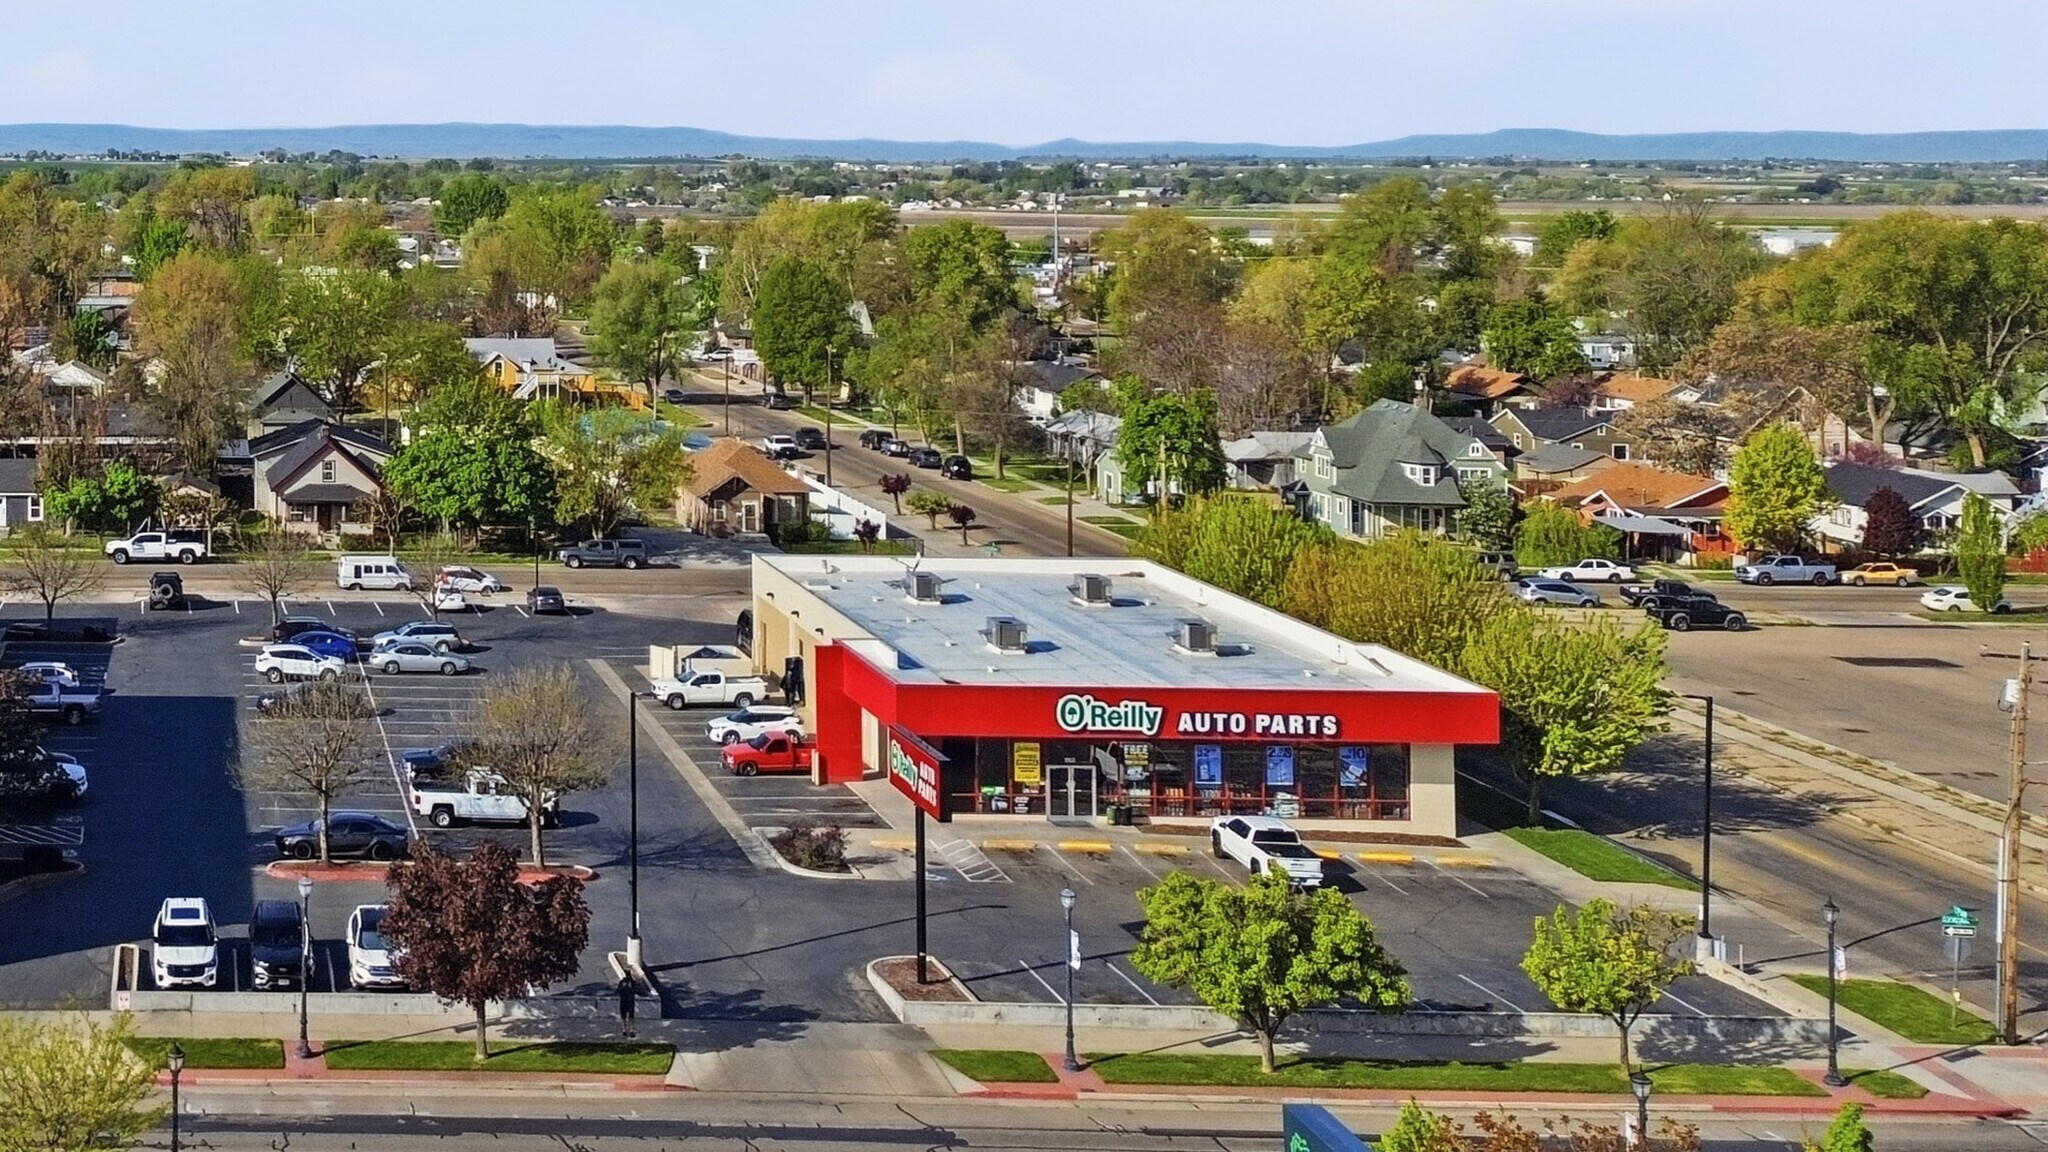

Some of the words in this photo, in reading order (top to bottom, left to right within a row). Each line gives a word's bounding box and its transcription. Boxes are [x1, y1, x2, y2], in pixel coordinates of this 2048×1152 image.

[1058, 695, 1161, 733] O'Reilly
[1177, 712, 1246, 733] AUTO
[1255, 713, 1338, 735] PARTS
[1124, 744, 1149, 755] FREE
